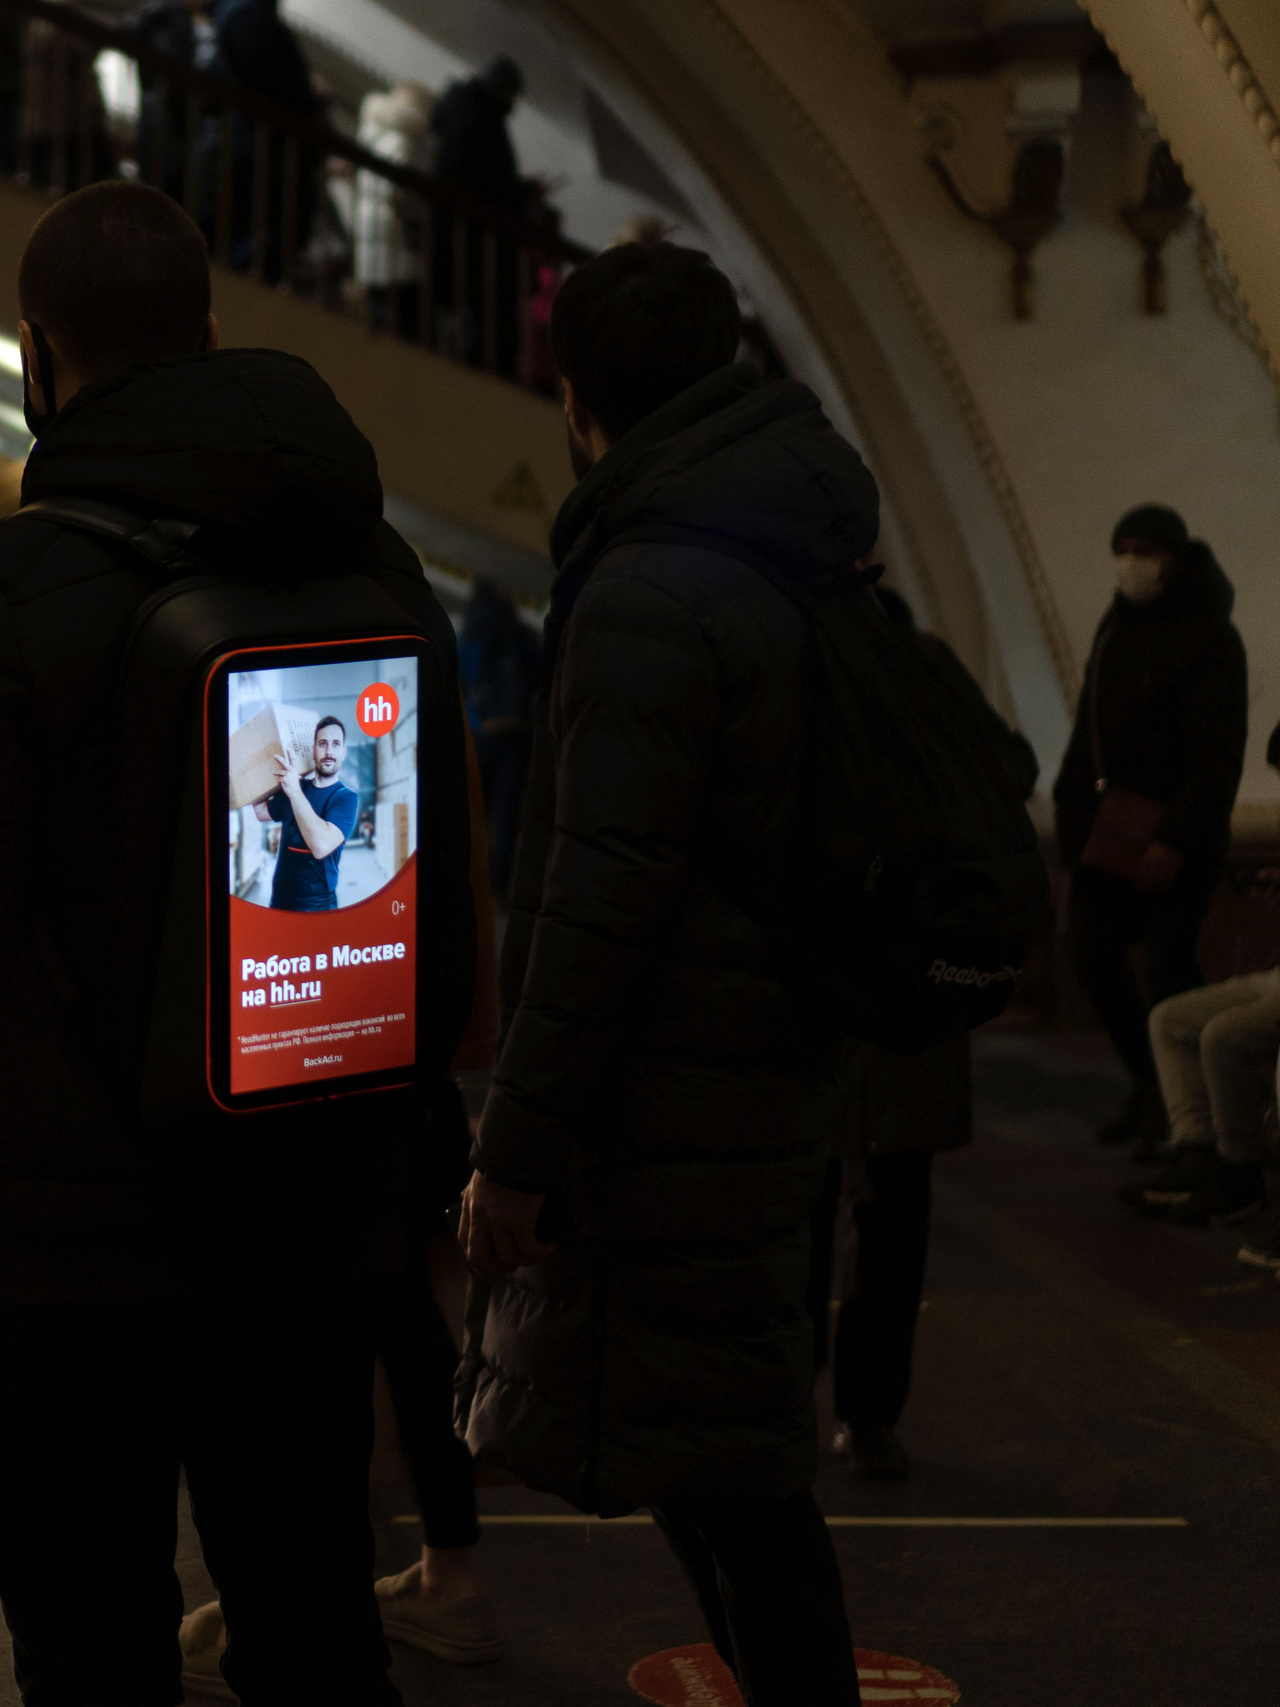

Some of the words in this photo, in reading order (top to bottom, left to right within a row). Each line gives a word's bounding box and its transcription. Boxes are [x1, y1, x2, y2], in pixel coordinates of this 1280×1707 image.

[364, 695, 392, 723] hh
[392, 900, 406, 915] 0+
[241, 955, 311, 981] Работа
[316, 953, 328, 970] в
[332, 942, 406, 968] Москве
[926, 958, 1004, 988] Reebo
[241, 988, 266, 1008] на
[270, 979, 321, 1004] hh.ru
[303, 1054, 343, 1067] BackAd.ru
